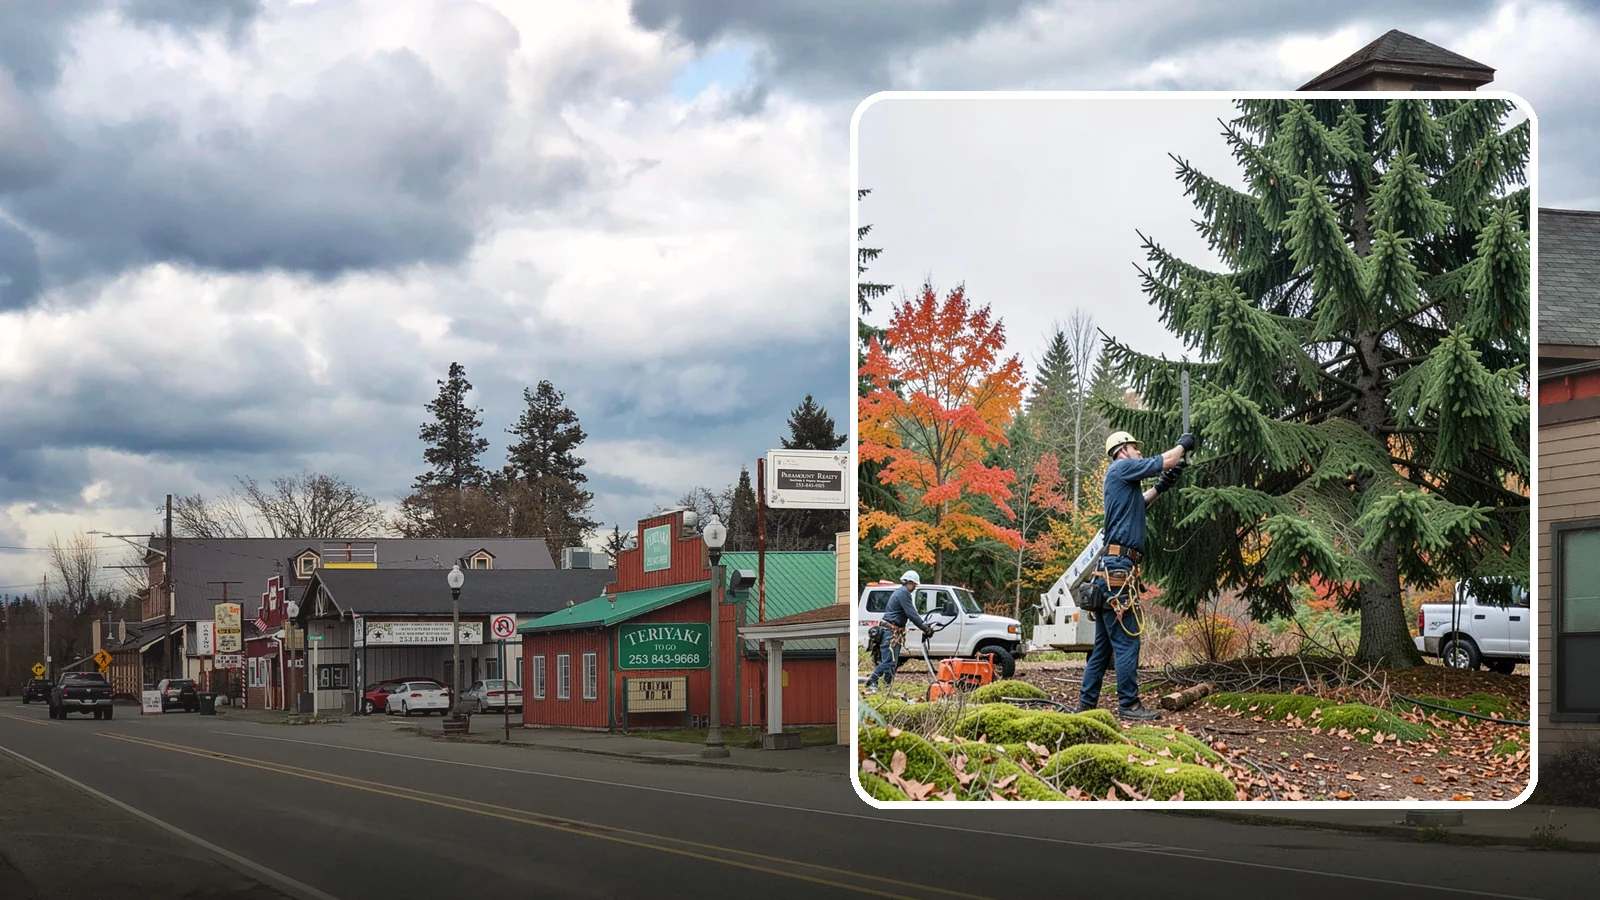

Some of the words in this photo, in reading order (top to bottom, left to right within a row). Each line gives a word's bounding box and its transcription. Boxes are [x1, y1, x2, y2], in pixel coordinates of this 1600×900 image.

[781, 472, 814, 480] PARAMOUNT
[625, 627, 702, 646] TERIYAKI
[629, 654, 648, 664] 253
[652, 654, 700, 664] 843-9668
[639, 682, 672, 691] TERIYAKI
